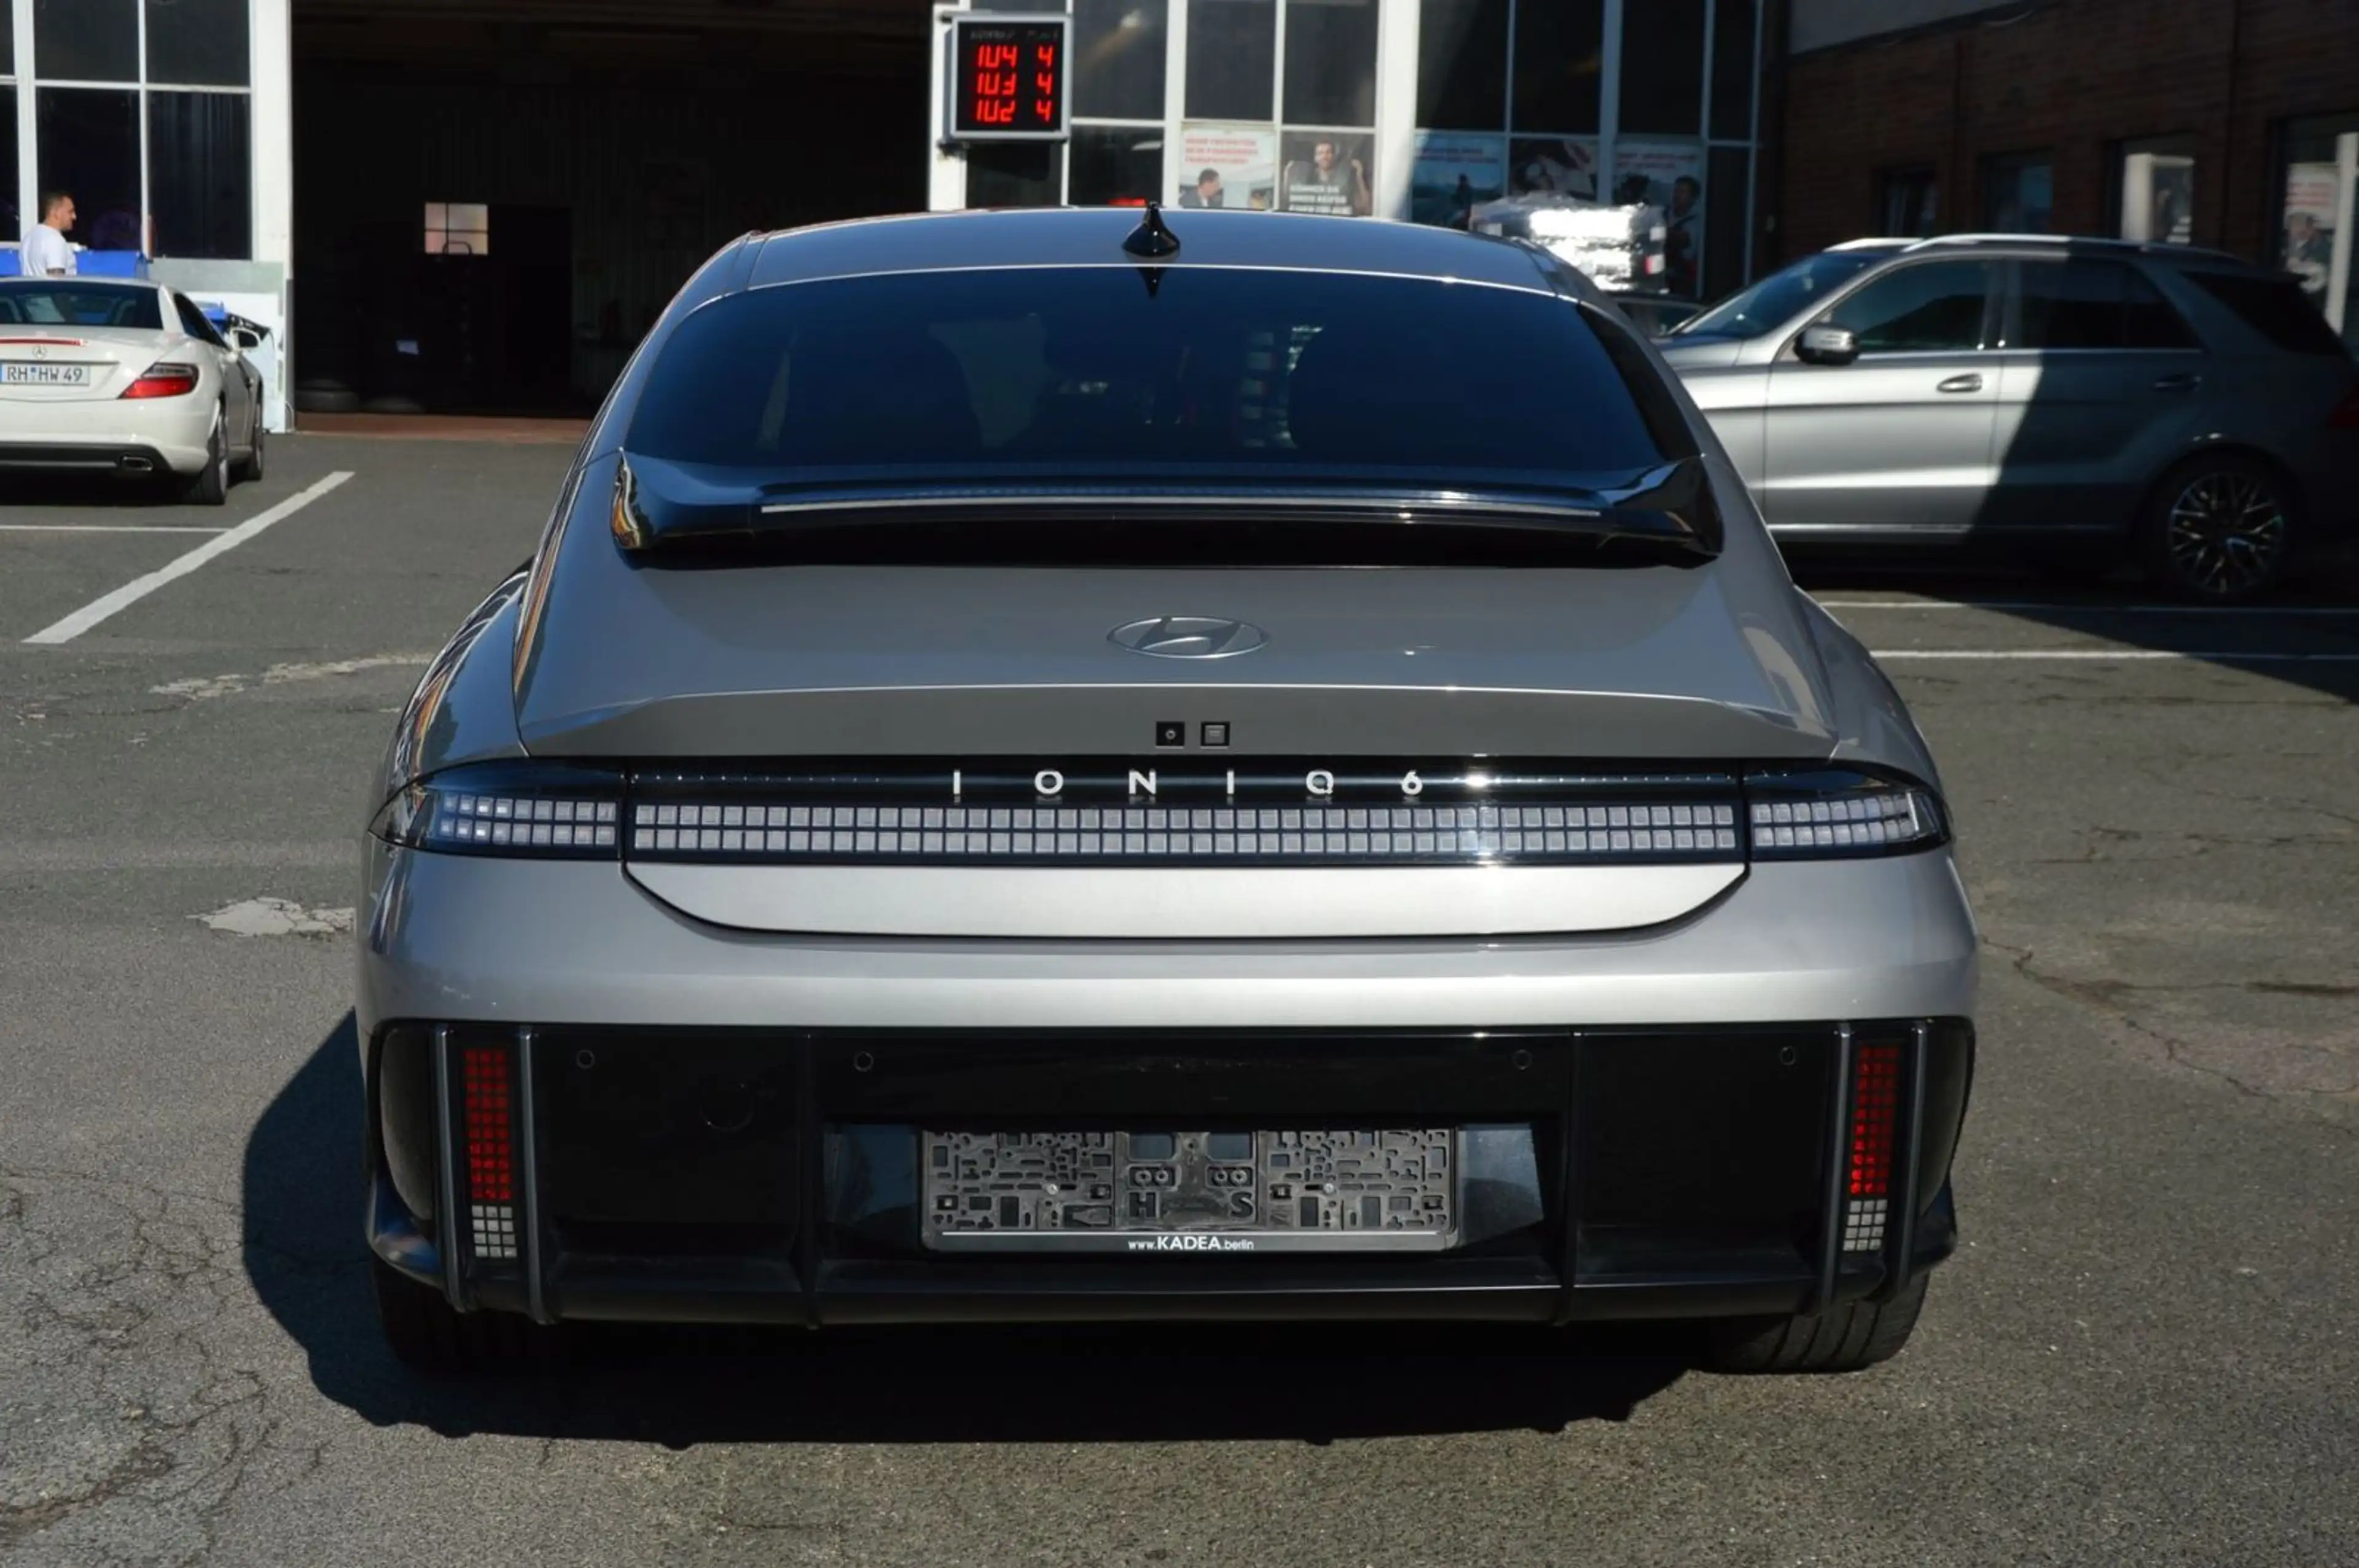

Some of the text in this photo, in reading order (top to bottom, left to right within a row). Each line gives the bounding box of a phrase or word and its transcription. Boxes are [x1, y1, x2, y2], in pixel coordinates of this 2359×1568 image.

[978, 44, 1053, 68] 104 4
[977, 72, 1052, 96] 103 4
[976, 99, 1052, 122] 102 4
[7, 365, 83, 382] RH HW 49
[1401, 770, 1423, 795] 6
[1128, 1236, 1254, 1250] www.KADEA.berlin
